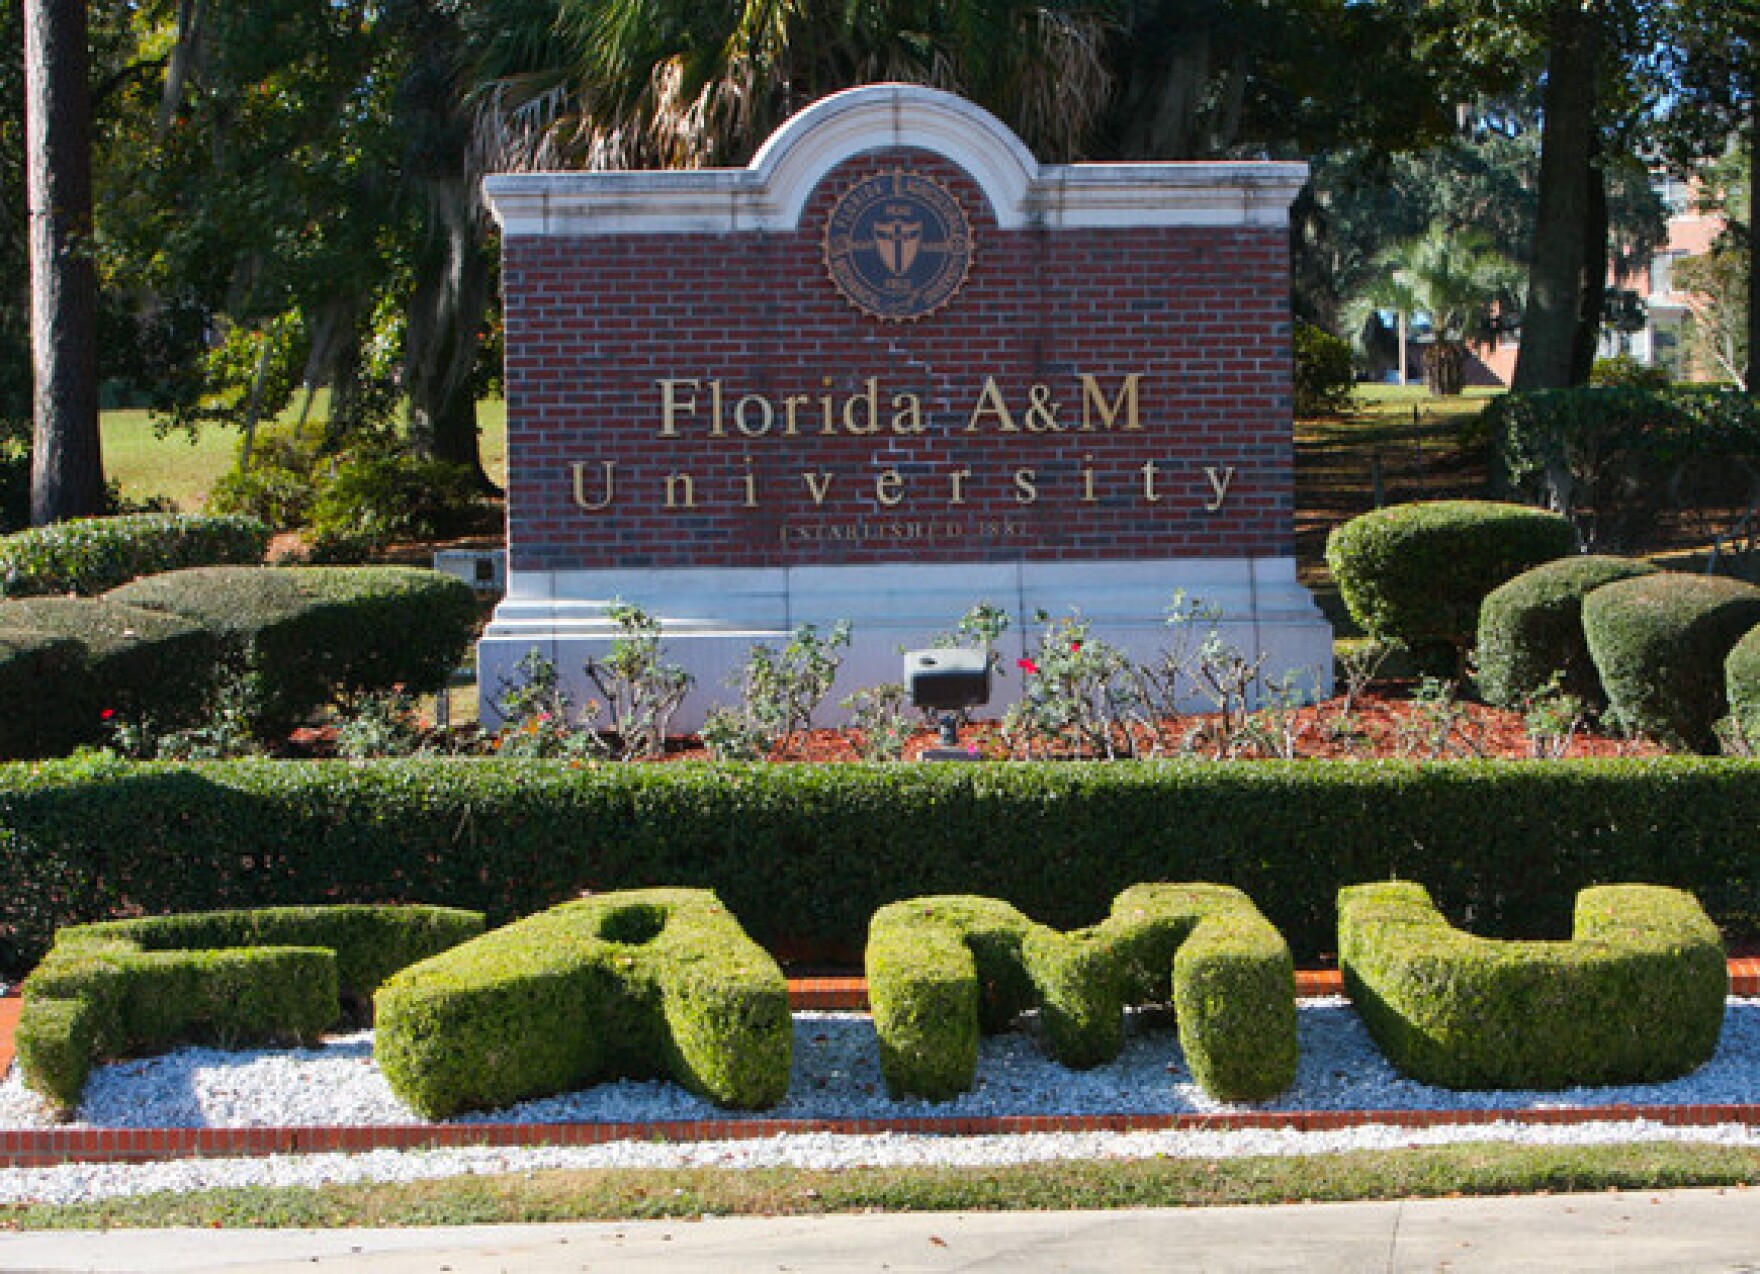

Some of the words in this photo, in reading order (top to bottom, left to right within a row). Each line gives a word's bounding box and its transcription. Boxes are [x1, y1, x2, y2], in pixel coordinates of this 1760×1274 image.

[656, 376, 926, 437] Florida
[965, 373, 1144, 432] A&M
[569, 454, 1236, 512] University
[15, 880, 1727, 1120] FAMU
